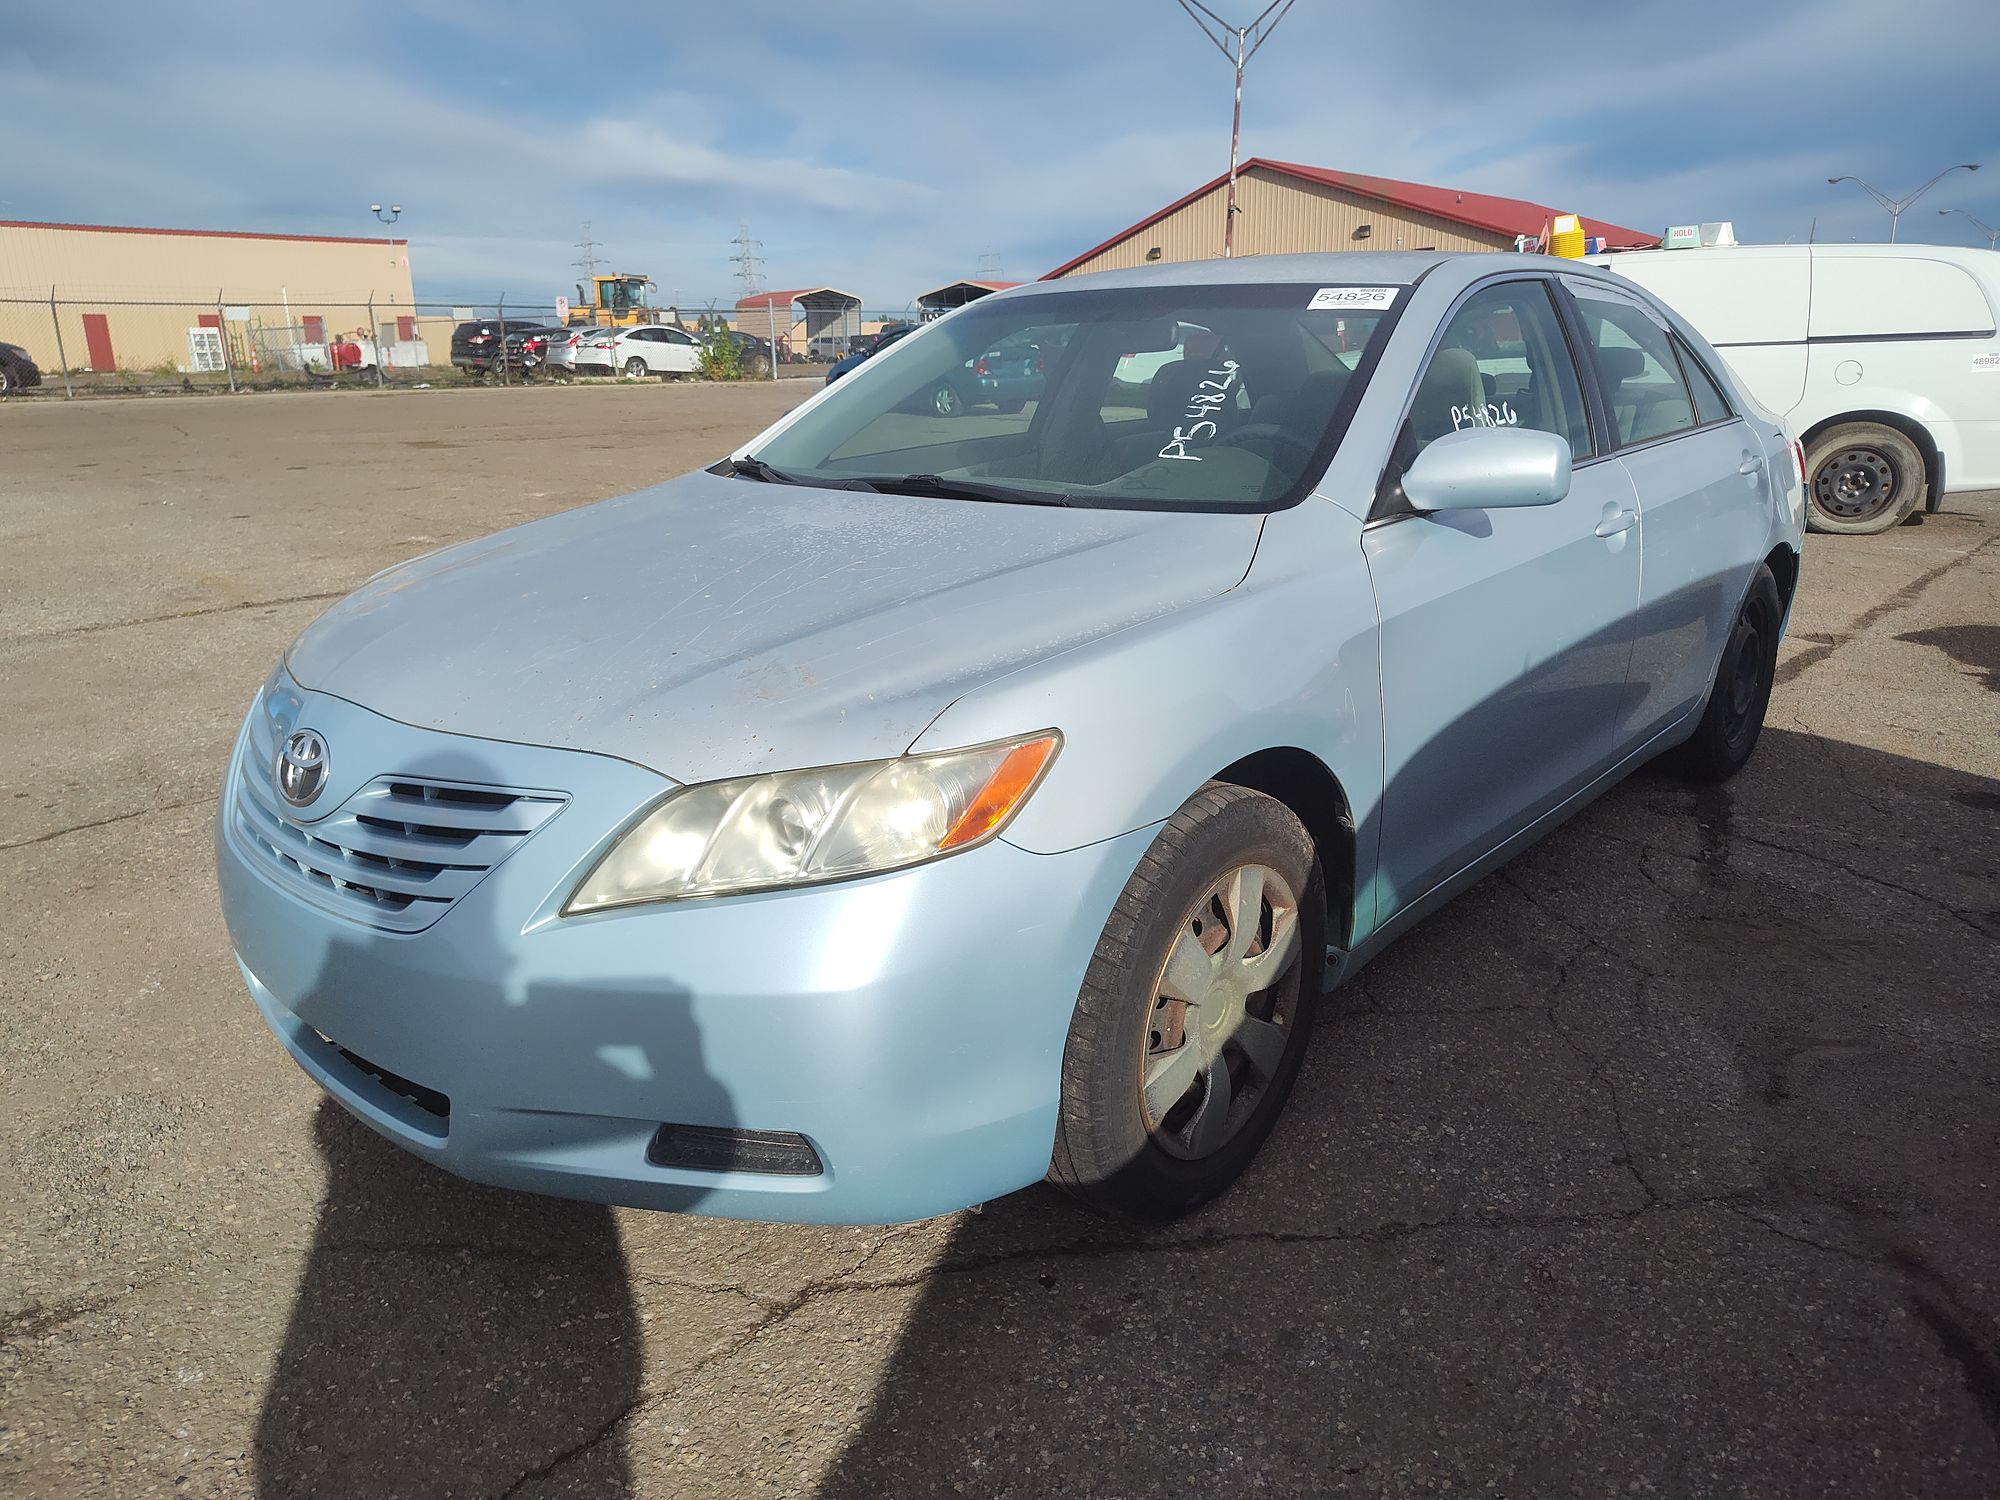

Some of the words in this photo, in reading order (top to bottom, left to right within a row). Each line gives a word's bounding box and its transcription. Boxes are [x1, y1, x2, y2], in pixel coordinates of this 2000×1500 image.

[1673, 228, 1693, 237] HOLD
[1316, 292, 1386, 302] 54826
[1158, 359, 1240, 461] P54826
[1451, 401, 1518, 431] P54826
